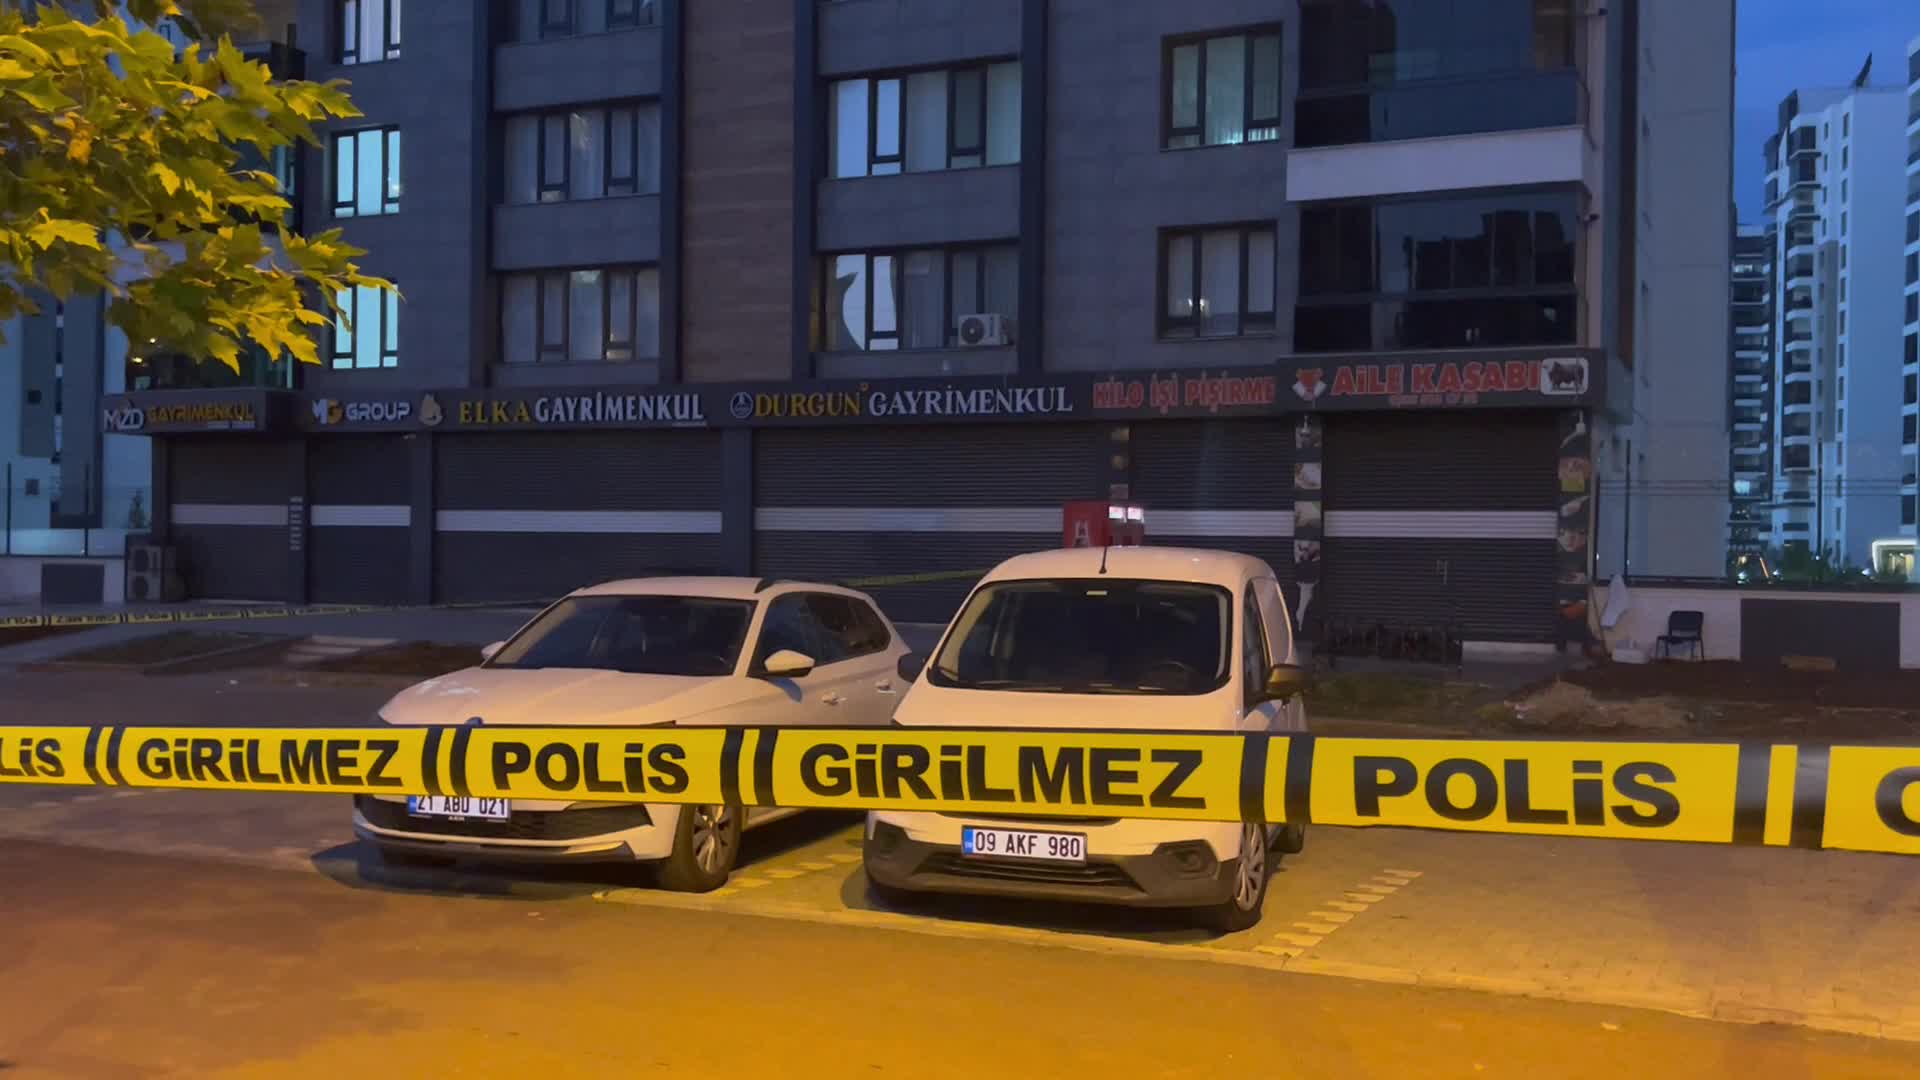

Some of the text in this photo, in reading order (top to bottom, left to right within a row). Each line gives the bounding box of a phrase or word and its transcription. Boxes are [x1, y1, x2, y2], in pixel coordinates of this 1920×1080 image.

[1411, 360, 1542, 392] KASABI
[345, 402, 412, 422] GROUP
[459, 391, 705, 424] ELKA GAYRİMENKUL
[754, 384, 1074, 417] DURGUN GAYRİMENKUL
[417, 796, 433, 811] 21
[975, 831, 996, 852] 09
[1005, 833, 1038, 855] AKF
[1048, 836, 1081, 858] 980
